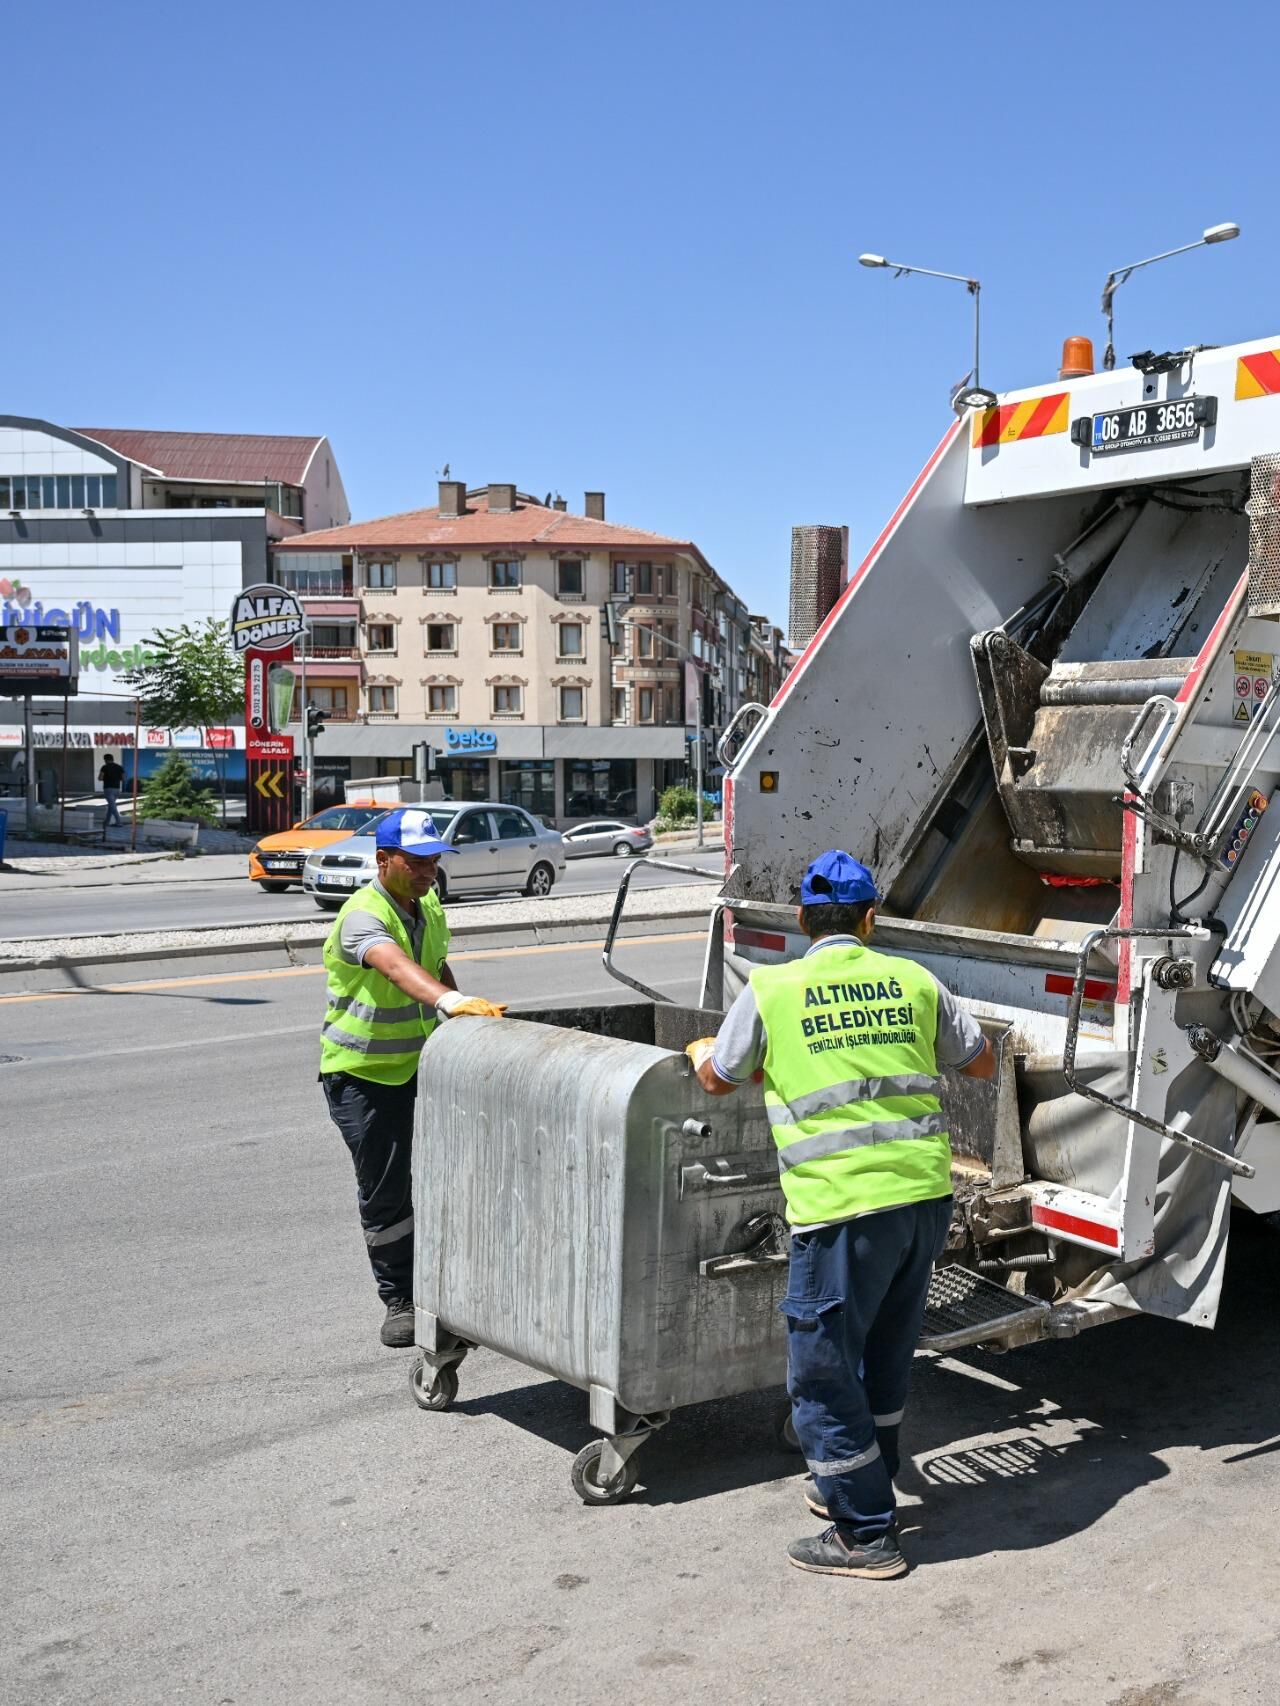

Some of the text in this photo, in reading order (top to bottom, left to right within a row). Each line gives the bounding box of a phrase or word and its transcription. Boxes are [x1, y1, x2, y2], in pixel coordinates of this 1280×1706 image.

[1102, 402, 1195, 441] 06 AB 3656
[236, 597, 299, 622] ALFA
[237, 619, 301, 646] DÖNER
[32, 732, 92, 746] MOBLYA
[93, 732, 135, 746] HOME
[249, 739, 284, 748] DÖNERİN
[446, 727, 497, 746] beko
[261, 746, 289, 754] ALFASI
[804, 976, 904, 1008] ALTINDAĞ
[801, 1003, 914, 1038] BELEDİYESİ
[807, 1029, 916, 1055] TEMİZLİK İŞLERİ MÜDÜRLÜĞÜ
